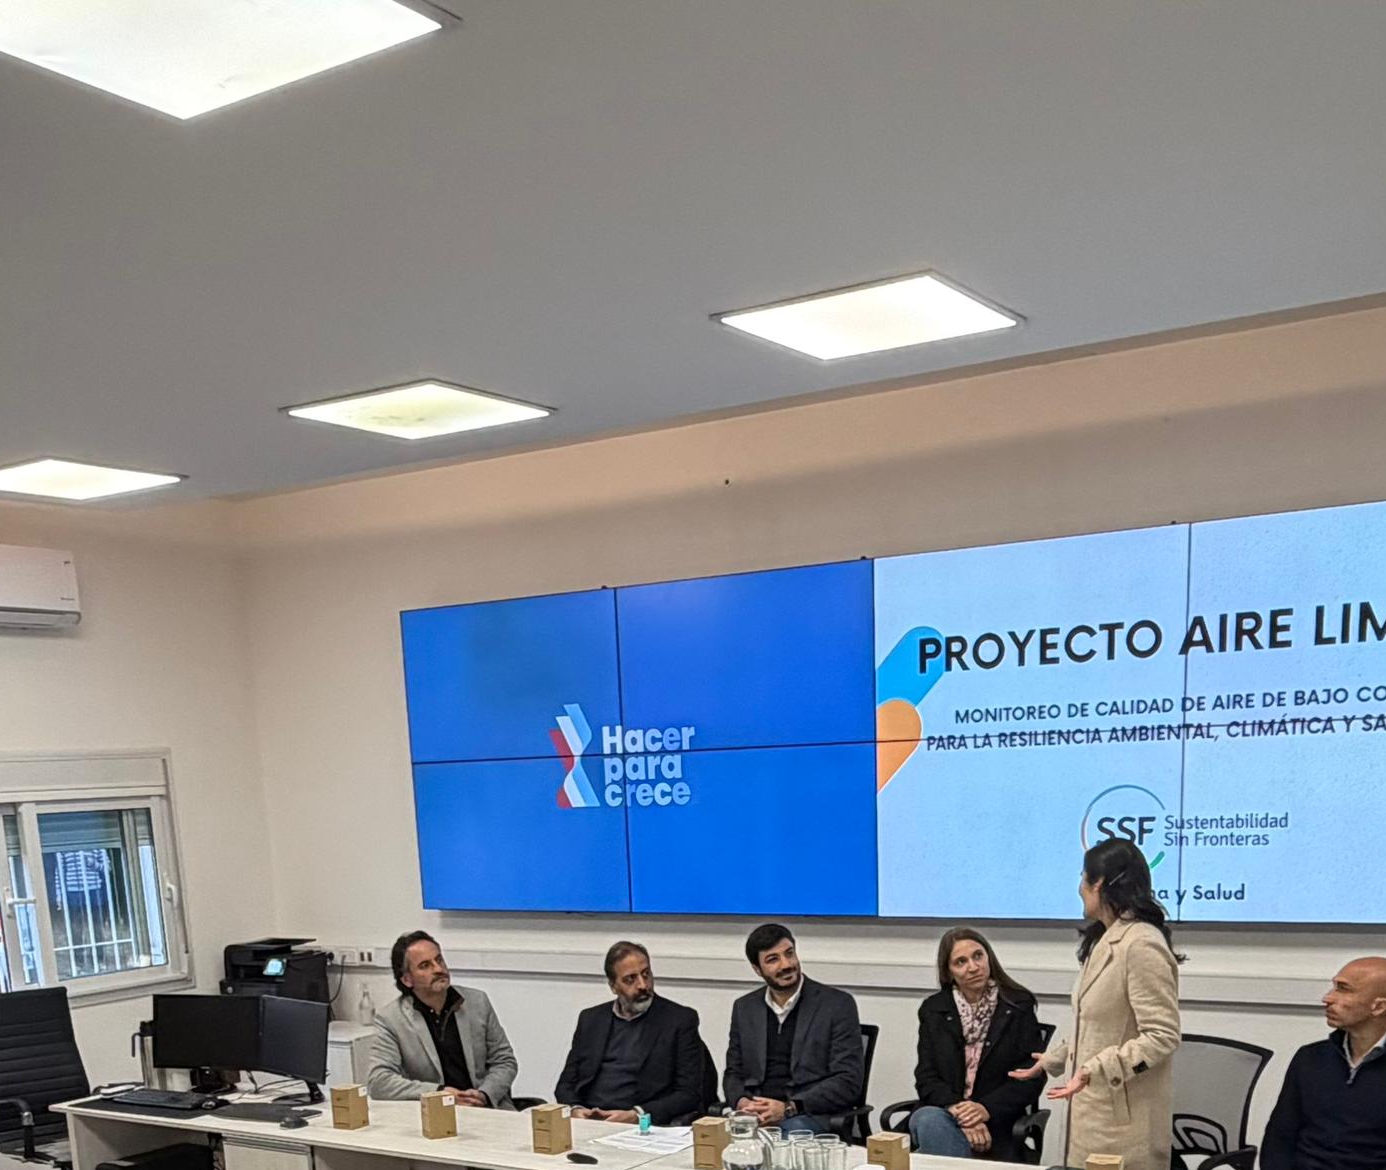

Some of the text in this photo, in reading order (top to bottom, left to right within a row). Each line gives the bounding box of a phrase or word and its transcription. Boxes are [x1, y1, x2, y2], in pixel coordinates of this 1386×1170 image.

[918, 619, 1163, 674] PROYECTO
[1179, 607, 1294, 655] AIRE
[955, 704, 1061, 724] MONITOREO
[1067, 702, 1089, 718] DE
[1095, 699, 1174, 716] CALIDAD
[1181, 696, 1206, 712] DE
[1212, 693, 1255, 711] AIRE
[1263, 691, 1287, 707] DE
[1294, 687, 1349, 706] BAJO
[601, 725, 696, 754] Hacer
[927, 735, 968, 750] PARA
[973, 733, 993, 749] LA
[998, 728, 1103, 748] RESILIENCIA
[1108, 722, 1219, 743] AMBIENTAL,
[1226, 713, 1335, 738] CLIMÁTICA
[1343, 715, 1356, 733] Y
[604, 754, 682, 786] para
[605, 782, 692, 808] crece
[1096, 815, 1157, 846] SSF
[1164, 812, 1290, 830] Sustentabilidad
[1164, 832, 1270, 847] Sin Fronteras
[1175, 888, 1188, 905] y
[1193, 883, 1246, 901] Salud
